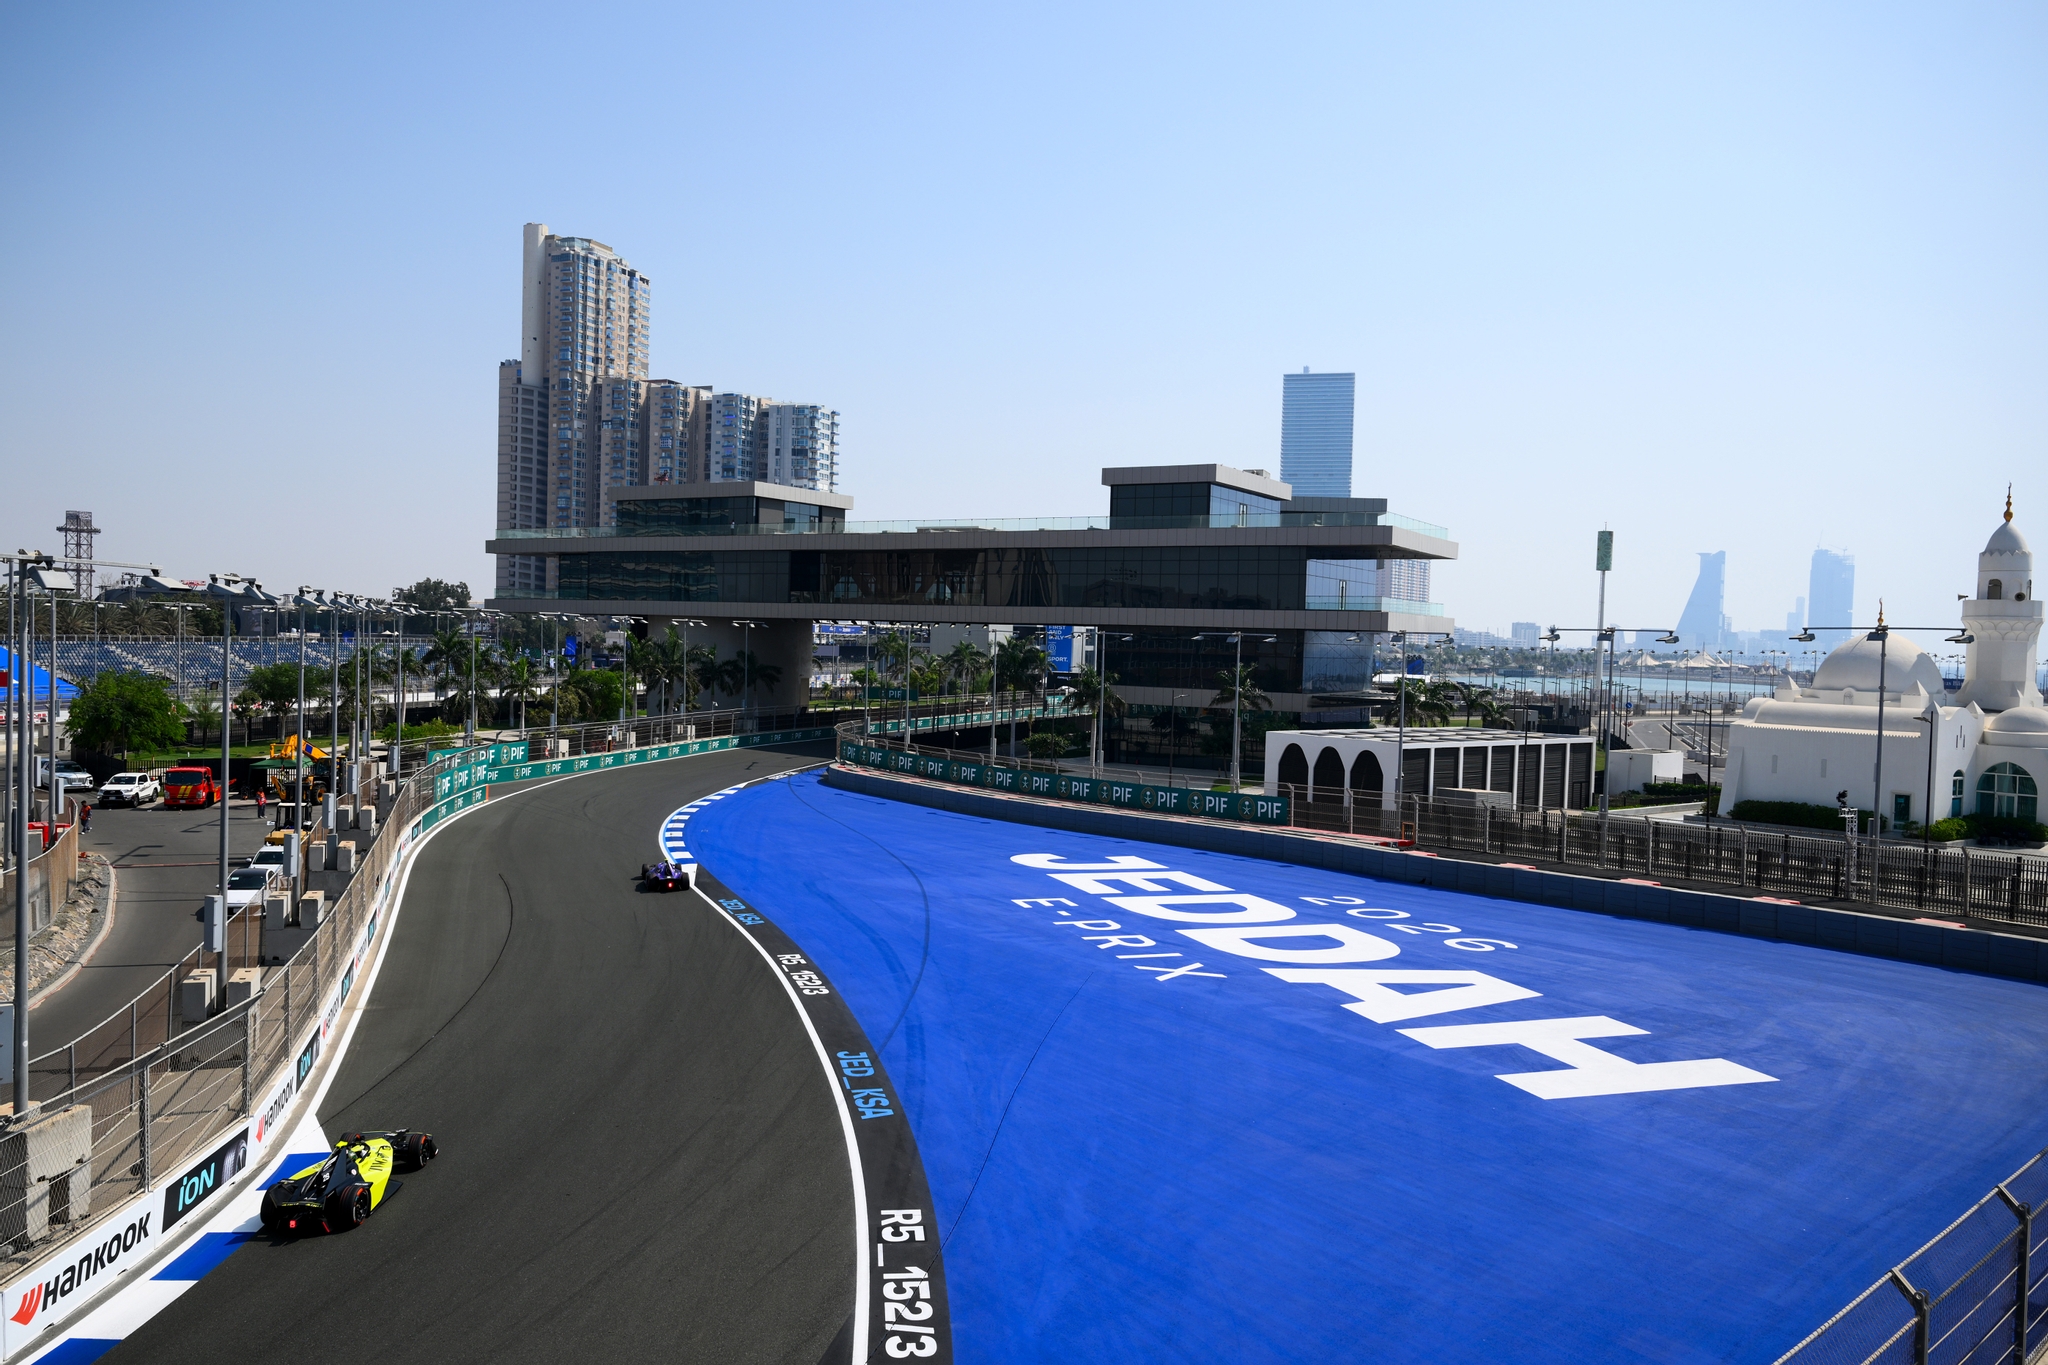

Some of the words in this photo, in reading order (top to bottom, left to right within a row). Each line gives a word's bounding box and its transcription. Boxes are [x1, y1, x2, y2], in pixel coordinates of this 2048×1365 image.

[888, 690, 902, 698] PIF
[511, 746, 525, 760] PIF
[605, 756, 613, 765] PIF
[870, 751, 882, 765] PIF
[552, 763, 561, 772] PIF
[580, 760, 588, 768] PIF
[898, 756, 913, 770] PIF
[928, 762, 943, 776] PIF
[458, 770, 468, 787] PIF
[477, 765, 487, 781] PIF
[488, 771, 498, 781] PIF
[521, 767, 531, 776] PIF
[962, 766, 976, 781] PIF
[996, 772, 1012, 787] PIF
[442, 777, 450, 795] PIF
[1032, 777, 1050, 792] PIF
[1072, 781, 1090, 797] PIF
[1113, 786, 1132, 803] PIF
[1158, 791, 1178, 808] PIF
[1206, 796, 1228, 813] PIF
[1257, 801, 1282, 818] PIF
[718, 898, 764, 926] JED_KSA
[1298, 895, 1519, 953] 2026
[1011, 896, 1228, 982] E-PRIX
[777, 953, 830, 996] R5_152/3
[1009, 853, 1780, 1100] JEDDAH
[836, 1051, 894, 1120] JED_KSA
[877, 1208, 938, 1358] R5_152/3
